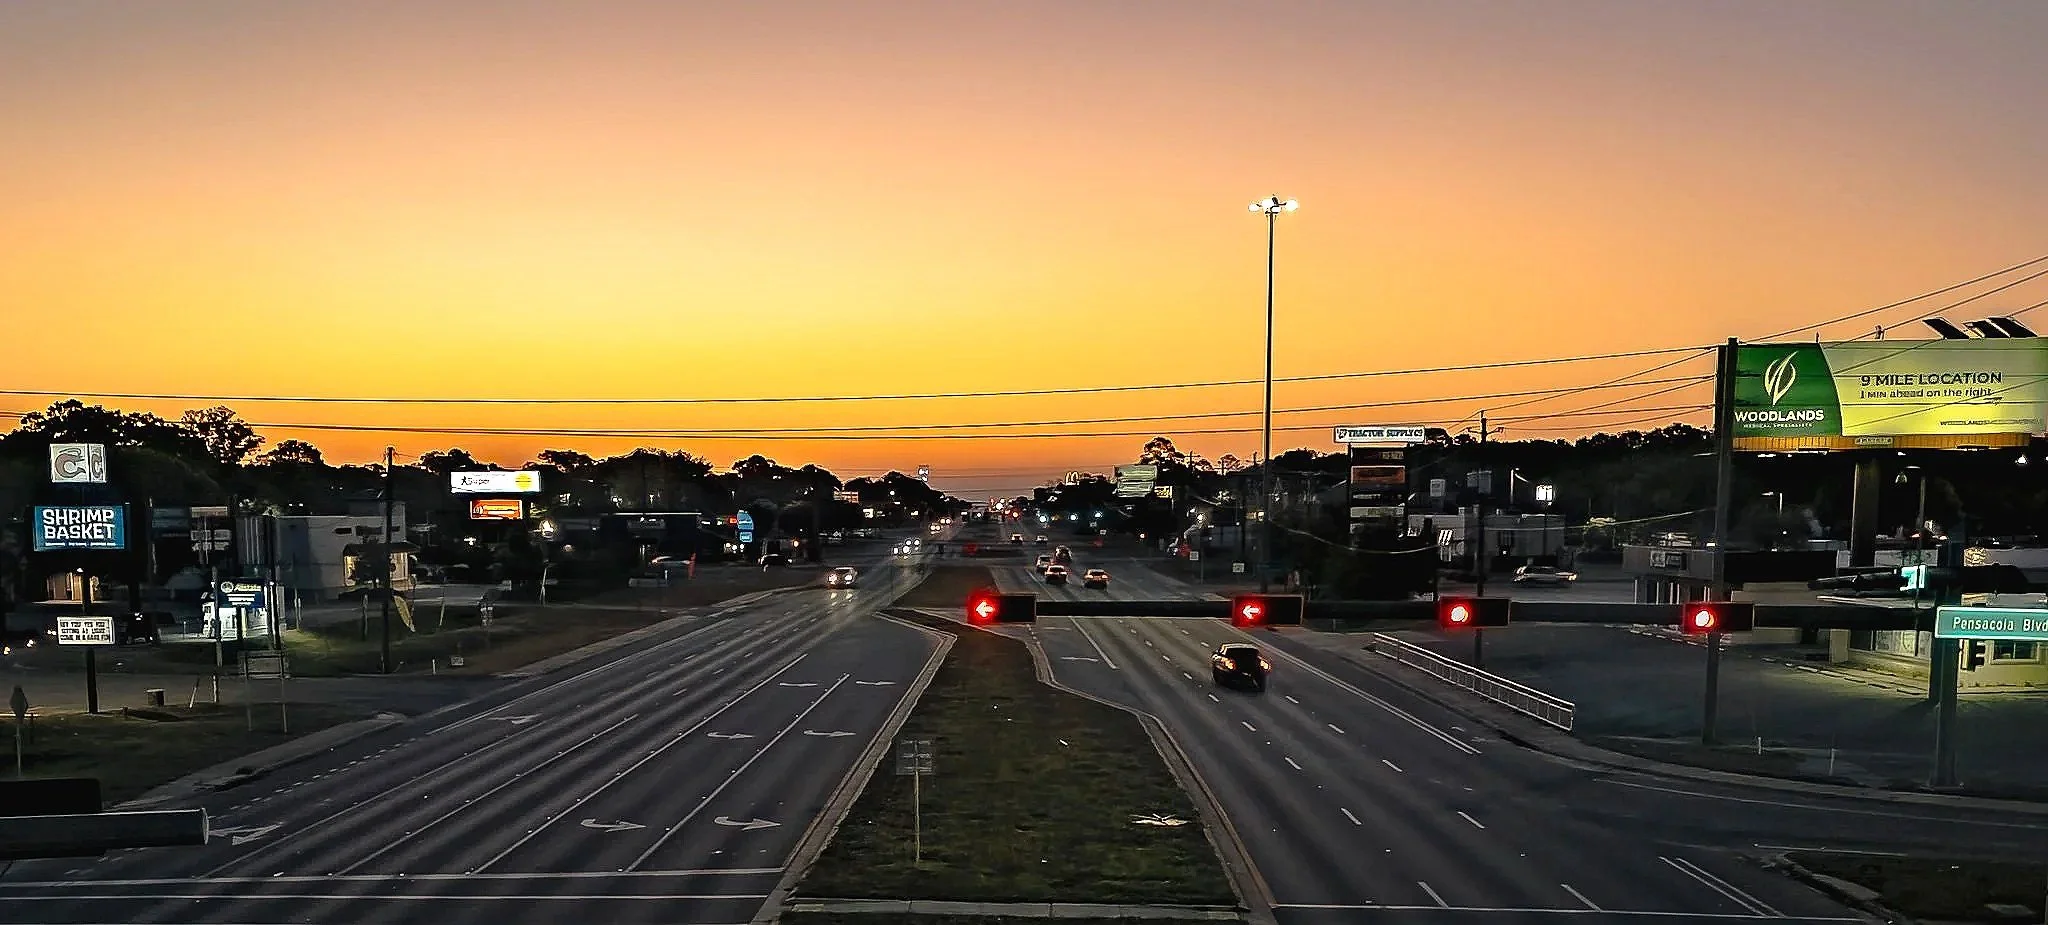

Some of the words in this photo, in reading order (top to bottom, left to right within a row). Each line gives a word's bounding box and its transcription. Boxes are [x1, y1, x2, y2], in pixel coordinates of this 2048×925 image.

[1861, 375, 1870, 386] 9
[1875, 374, 1914, 386] MILE
[1919, 371, 2001, 385] LOCATION
[1890, 389, 1923, 398] ahead
[1926, 389, 1940, 397] on
[1944, 388, 1962, 397] the
[1965, 387, 1992, 399] right
[1735, 410, 1825, 421] WOODLANDS
[42, 508, 115, 526] SHRIMP
[43, 522, 116, 540] BASKET
[1953, 616, 2014, 631] Pensacola
